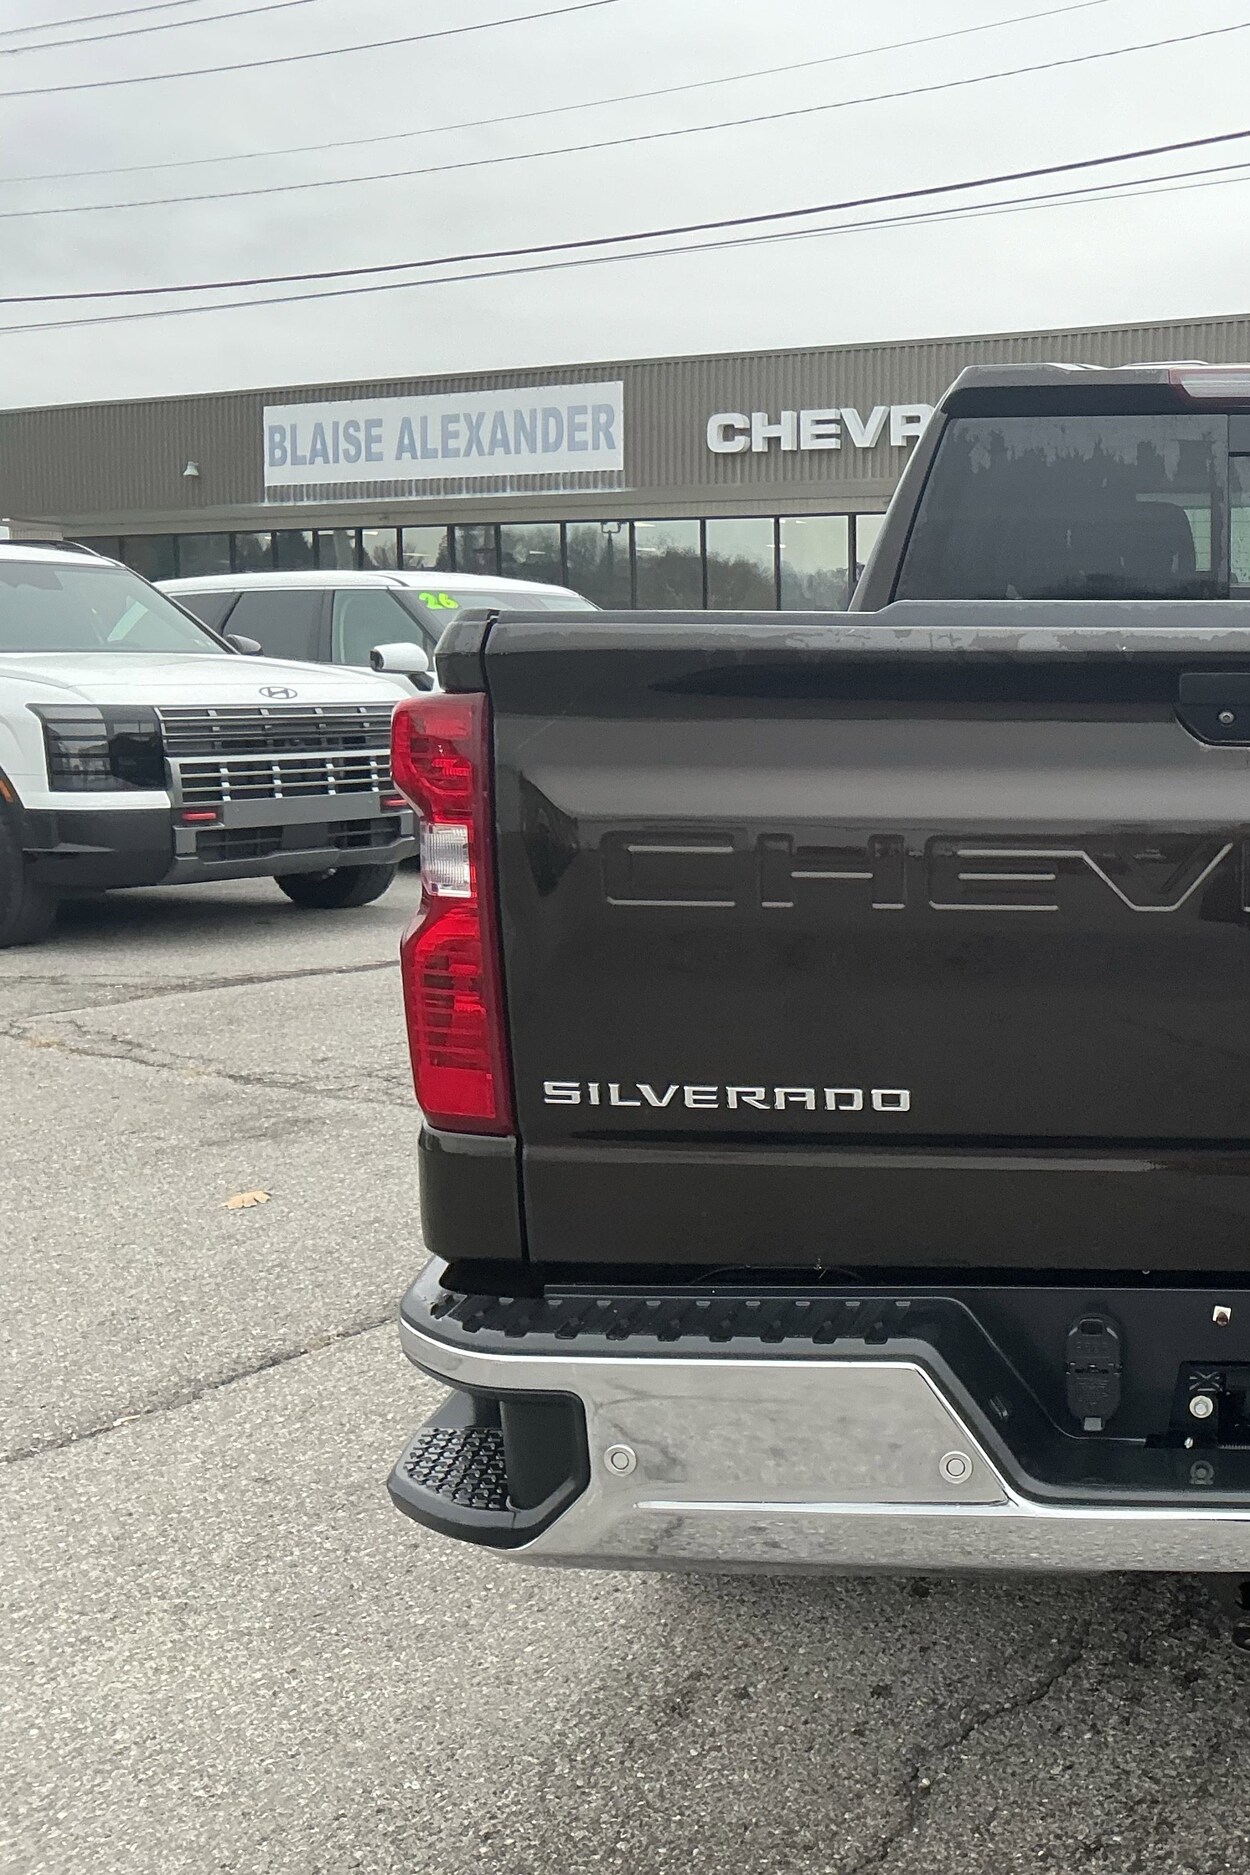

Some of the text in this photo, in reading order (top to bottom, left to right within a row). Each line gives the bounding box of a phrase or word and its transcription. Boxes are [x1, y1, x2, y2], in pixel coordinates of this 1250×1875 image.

[268, 403, 616, 467] BLAISE ALEXANDER
[418, 592, 459, 610] 26
[543, 1081, 911, 1112] SILVERADO
